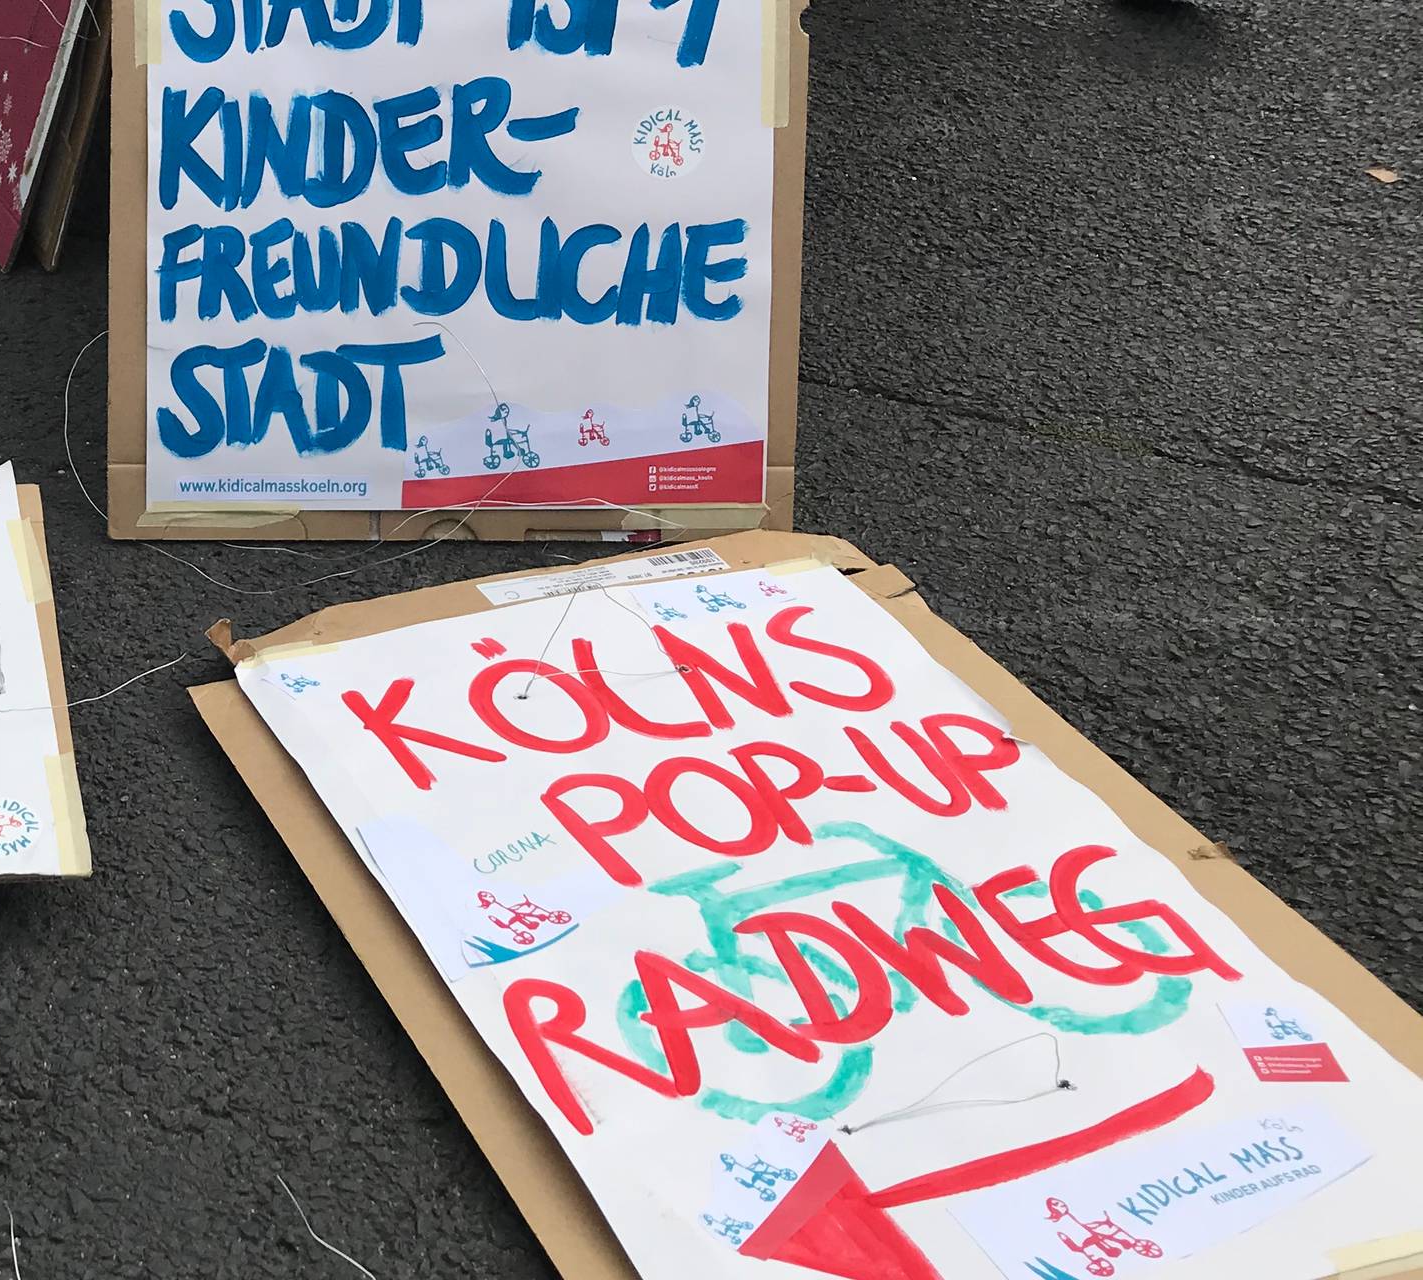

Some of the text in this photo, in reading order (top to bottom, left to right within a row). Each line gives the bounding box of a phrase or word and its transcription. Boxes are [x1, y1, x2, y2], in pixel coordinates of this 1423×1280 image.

[157, 76, 580, 212] KINDER-
[633, 108, 704, 153] KIDICAL MASS
[650, 162, 677, 178] Köln
[155, 217, 748, 327] FREUNDLICHE
[155, 334, 445, 459] STADT
[179, 479, 367, 496] www.kidicalmasskoeln.org
[343, 606, 895, 790] KÖLNS
[541, 713, 1020, 887] POP-UP
[503, 844, 1244, 1136] RADWEG
[1116, 1136, 1304, 1226] KIDICAL MASS
[1210, 1182, 1259, 1205] KINDER
[1293, 1164, 1323, 1182] RAD
